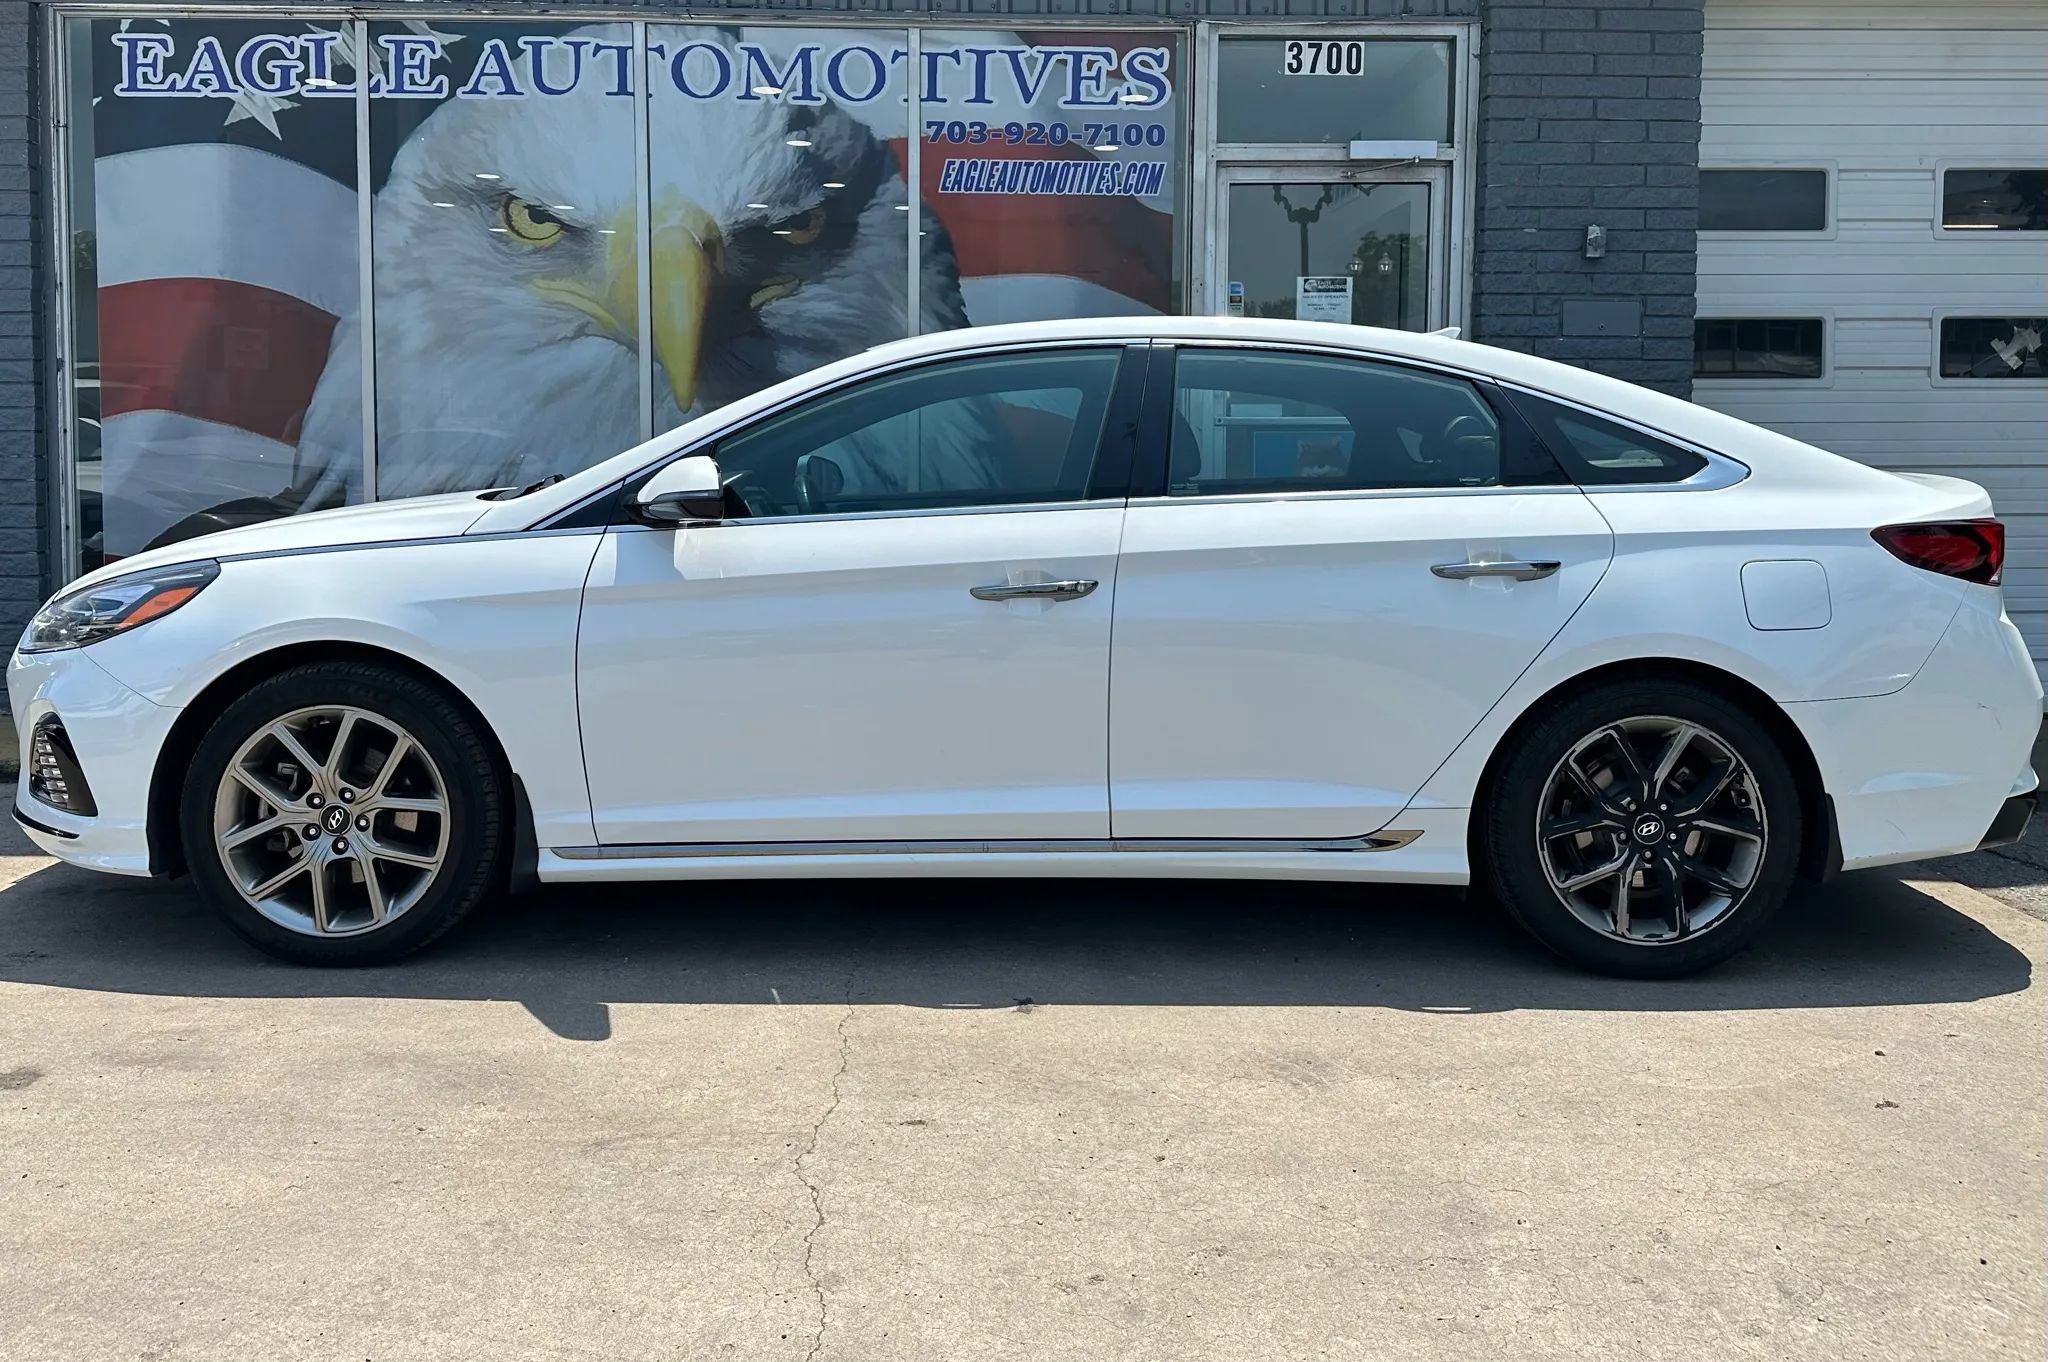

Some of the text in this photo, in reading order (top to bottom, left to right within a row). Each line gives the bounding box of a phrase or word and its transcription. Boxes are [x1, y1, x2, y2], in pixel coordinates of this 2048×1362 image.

[113, 33, 1171, 109] EAGLE AUTOMOTIVES
[1287, 42, 1362, 74] 3700
[926, 121, 1166, 147] 703-920-7100
[939, 159, 1166, 195] EAGLEAUTOMOTIVES.COM
